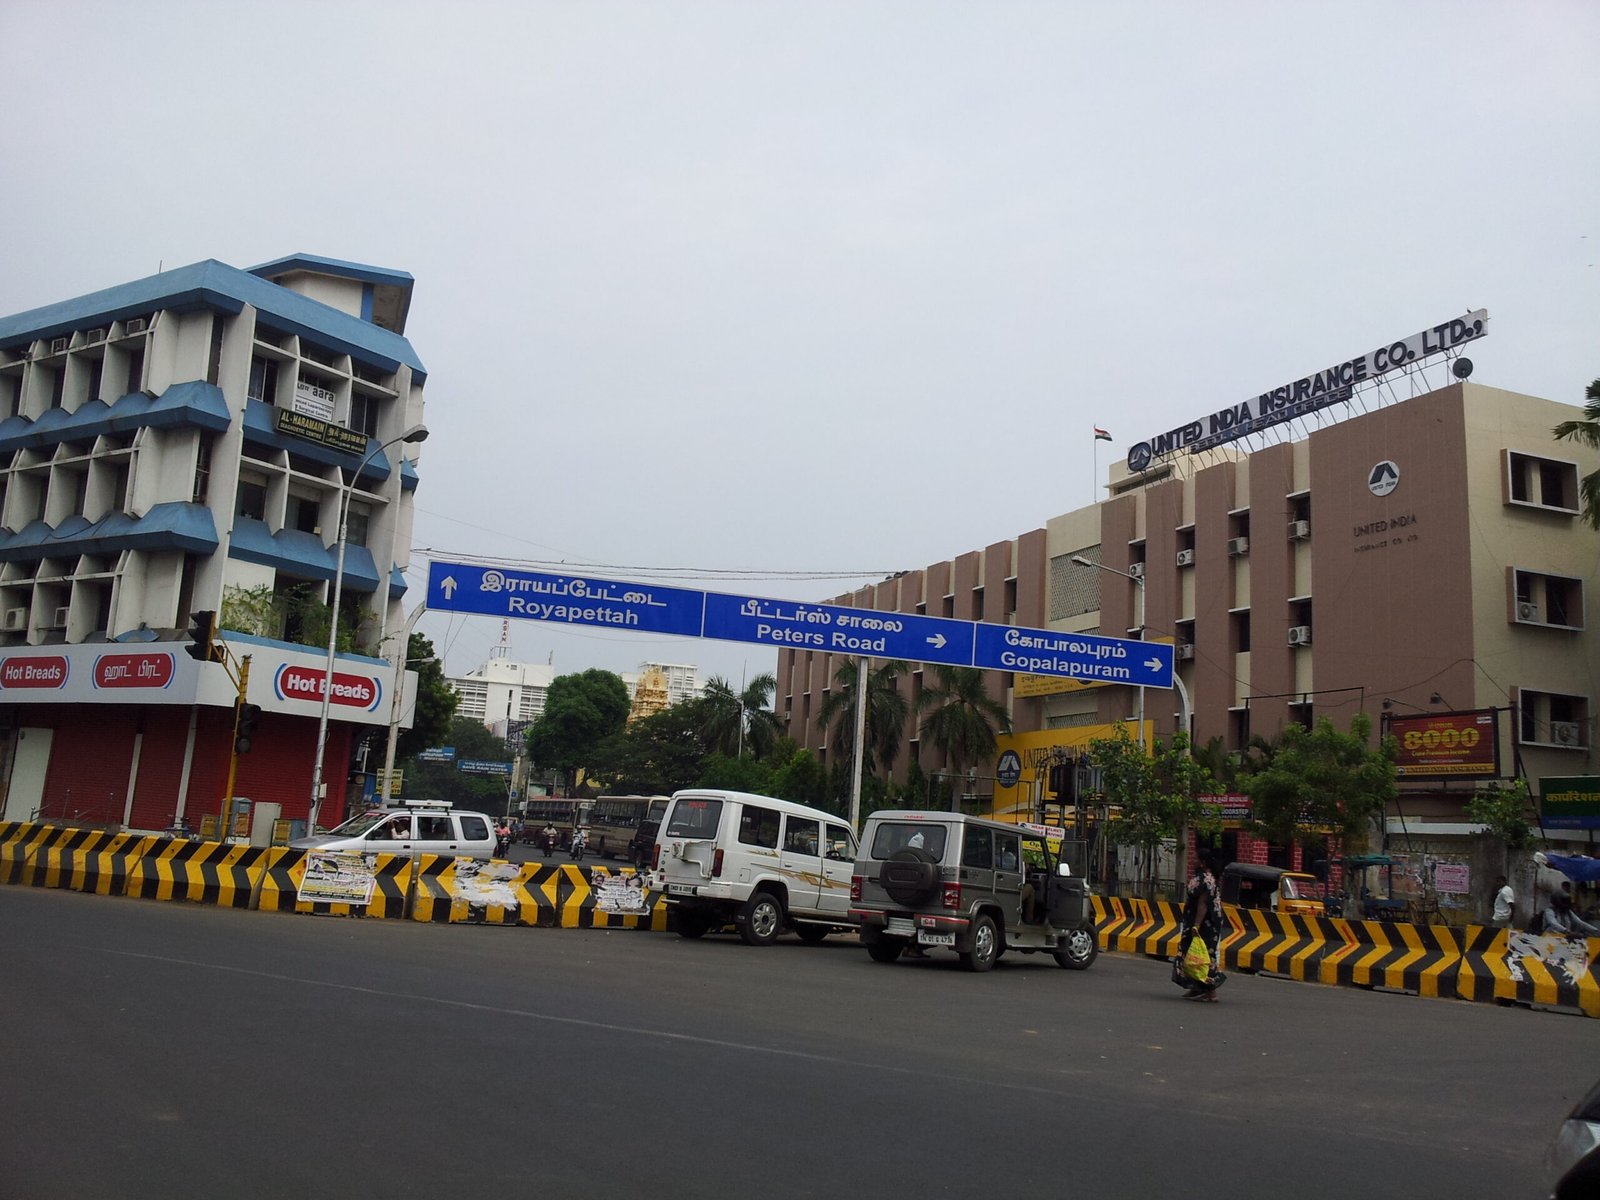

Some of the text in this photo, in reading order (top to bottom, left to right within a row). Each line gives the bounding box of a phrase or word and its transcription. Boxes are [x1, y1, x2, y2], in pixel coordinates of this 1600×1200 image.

[1151, 421, 1203, 456] UNITED
[1209, 401, 1253, 435] INDIA
[1258, 357, 1367, 416] INSURANCE
[1374, 341, 1415, 372] CO.
[1353, 513, 1417, 537] UNITED INDIA
[479, 569, 668, 607] இராயப்பேட்டை
[508, 596, 640, 625] Royapettah
[740, 599, 903, 633] பீட்டர்ஸ் சாலை
[756, 623, 886, 652] Peters Road
[1004, 628, 1127, 660] கோபாலபுரம்
[5, 664, 61, 680] Hot Breads
[1000, 651, 1131, 679] Gopalapuram
[287, 673, 371, 700] Hot Breads
[1403, 727, 1481, 750] 8000
